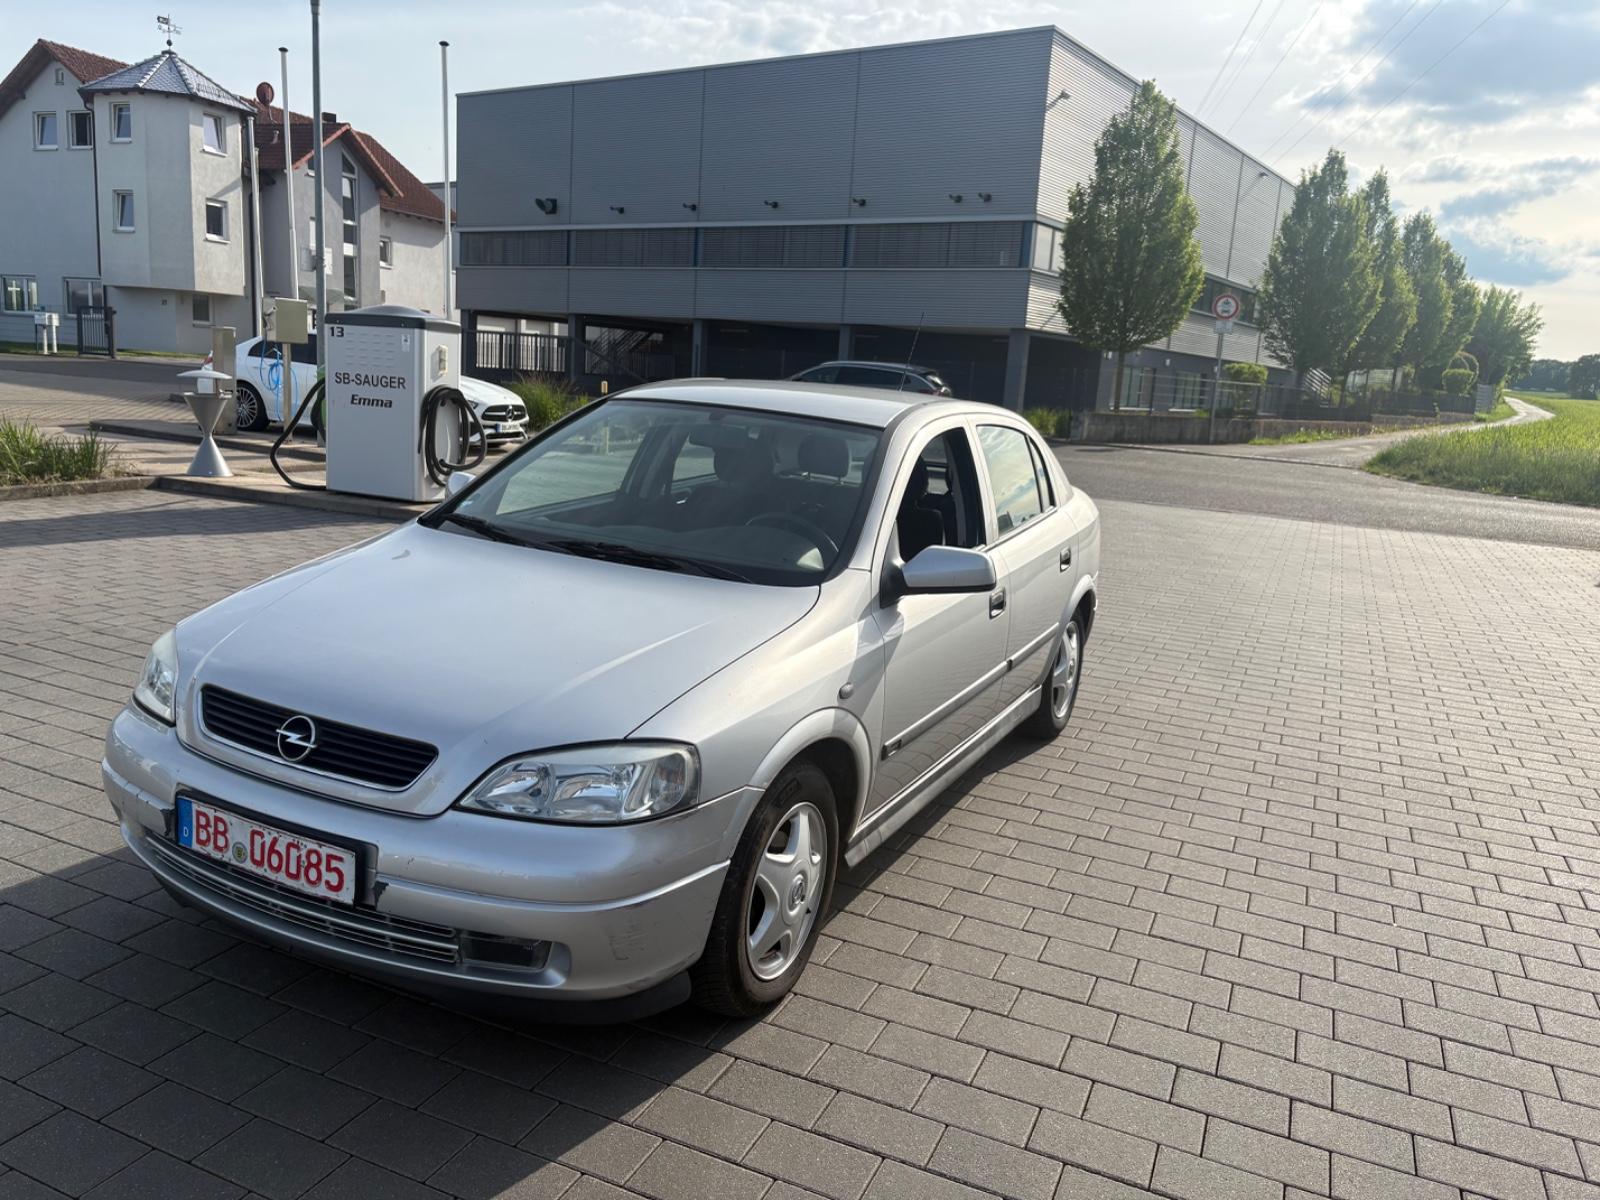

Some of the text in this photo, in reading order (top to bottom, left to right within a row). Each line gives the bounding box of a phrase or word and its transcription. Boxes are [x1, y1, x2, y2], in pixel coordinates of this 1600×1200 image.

[330, 326, 345, 338] 13
[334, 371, 406, 389] SB-SAUGER
[350, 394, 393, 408] Emma
[195, 809, 230, 853] BB
[250, 829, 345, 893] 06085
